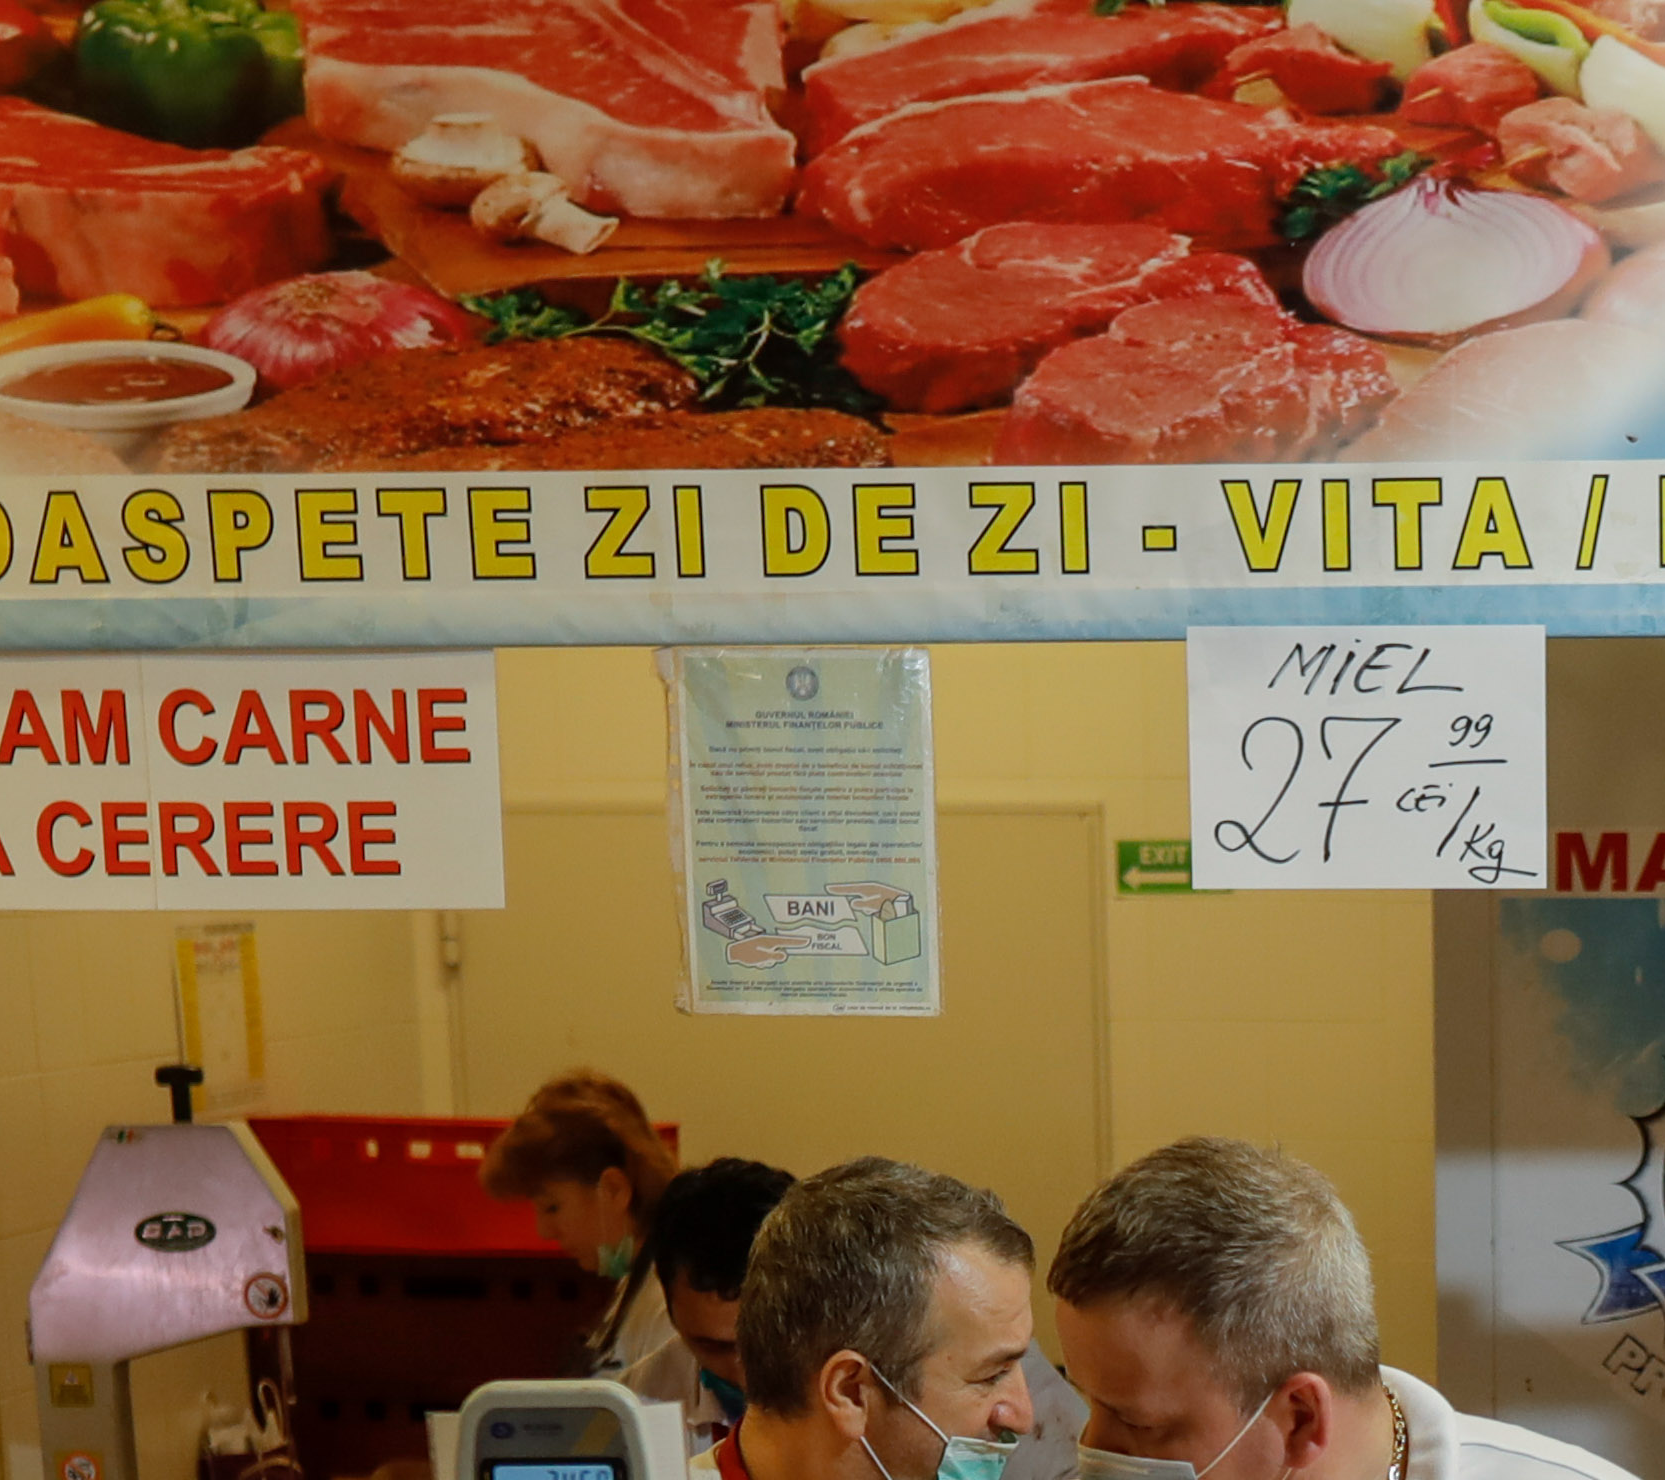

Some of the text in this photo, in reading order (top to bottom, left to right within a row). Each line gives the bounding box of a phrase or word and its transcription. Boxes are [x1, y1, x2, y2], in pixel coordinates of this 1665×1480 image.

[584, 485, 707, 579] ZI
[759, 483, 920, 577] DE
[968, 481, 1089, 575] ZI
[1221, 476, 1533, 572] VITA
[1575, 474, 1609, 570] /
[156, 686, 472, 766] CARNE
[1213, 713, 1494, 865] 27 99
[34, 799, 402, 878] CERERE
[787, 900, 835, 917] BANI
[811, 942, 843, 951] FISCAL
[817, 933, 836, 942] BON
